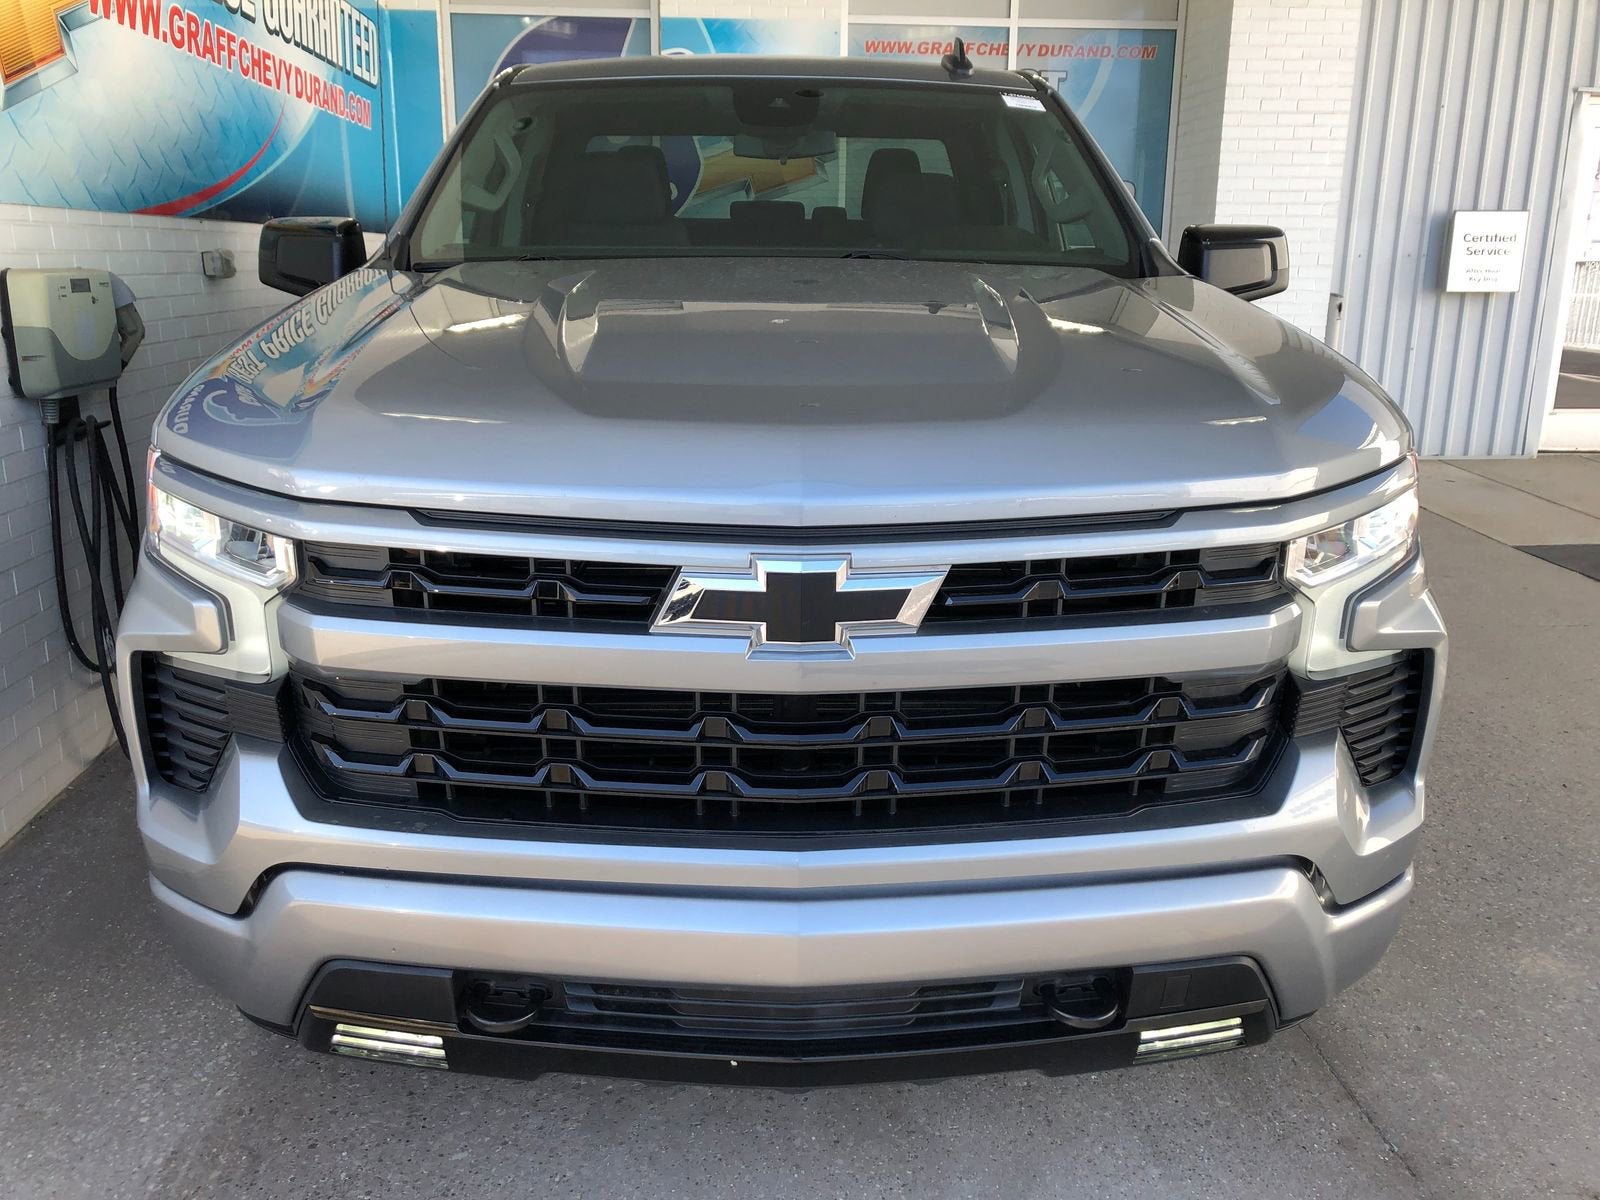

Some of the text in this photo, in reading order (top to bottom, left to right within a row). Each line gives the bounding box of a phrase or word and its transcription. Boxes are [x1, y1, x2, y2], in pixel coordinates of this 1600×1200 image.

[864, 39, 1157, 58] WWW.GRAFCHEYDURAND.COM
[1463, 233, 1517, 243] Certified
[1466, 246, 1511, 256] Service
